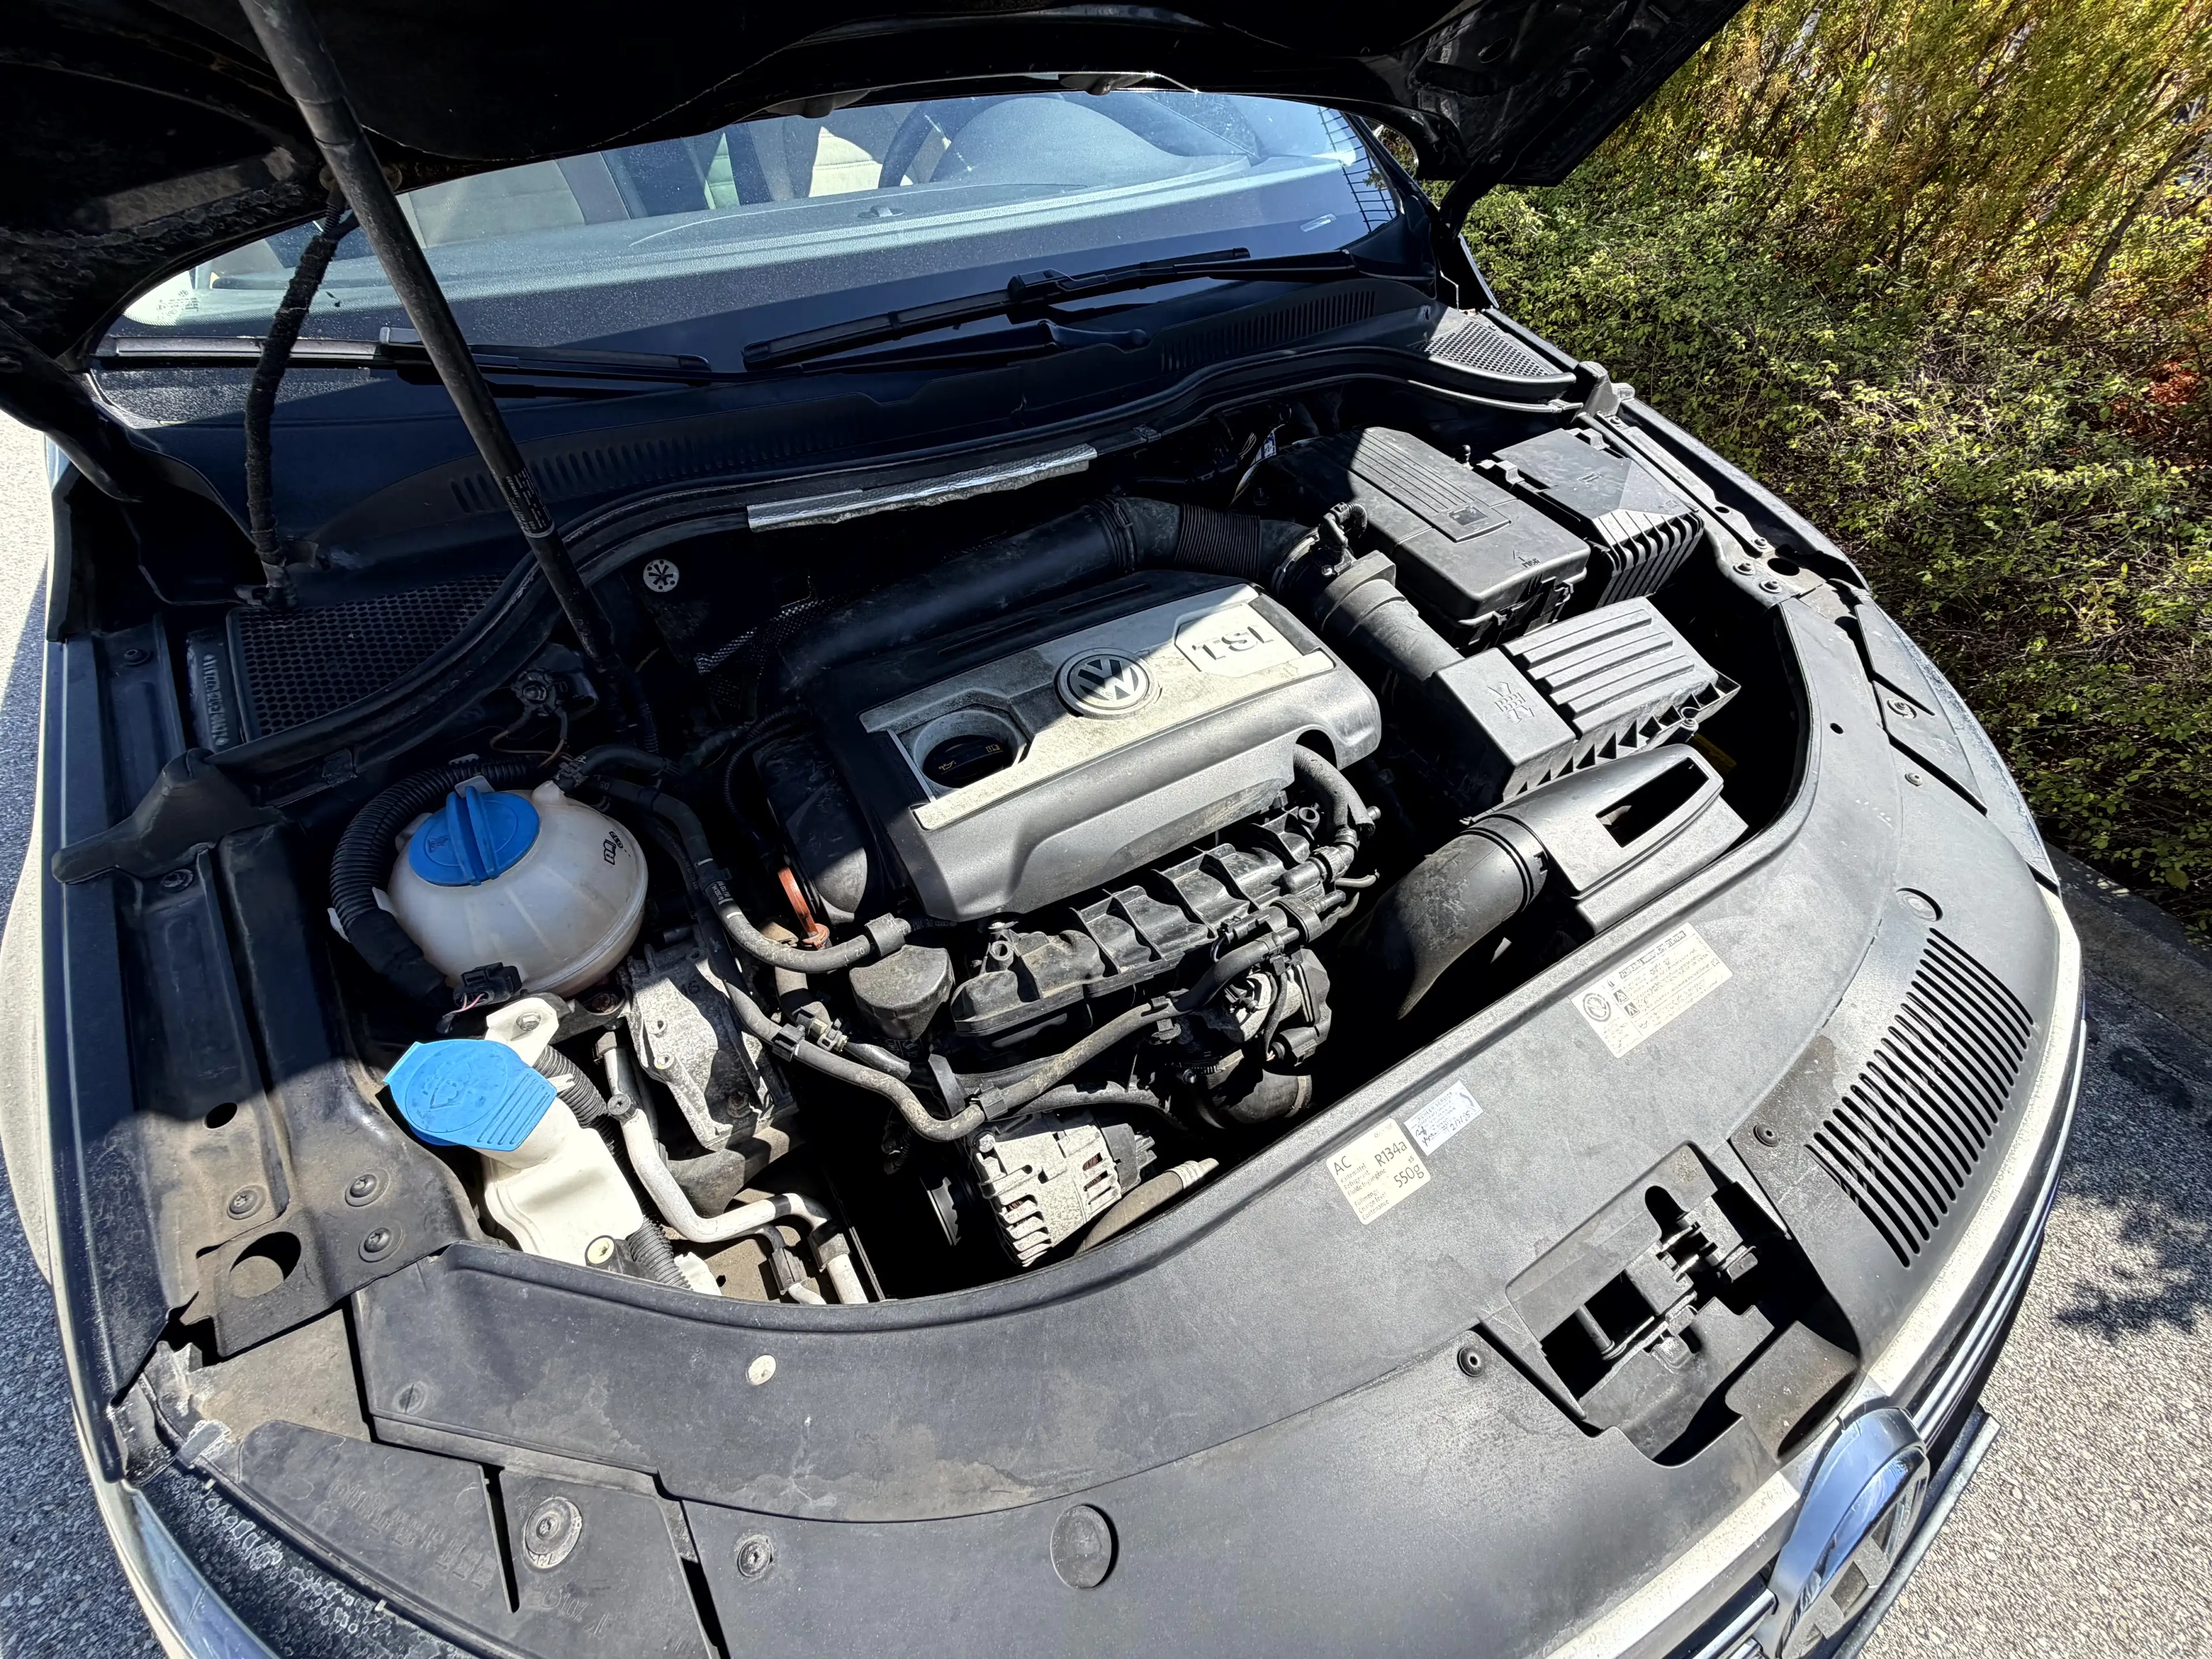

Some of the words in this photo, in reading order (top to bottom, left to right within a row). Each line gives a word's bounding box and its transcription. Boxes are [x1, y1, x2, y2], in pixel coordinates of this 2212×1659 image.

[1192, 625, 1274, 660] TSI
[1333, 1156, 1352, 1176] AC
[1374, 1141, 1408, 1167] R134a
[1393, 1164, 1424, 1188] 550g
